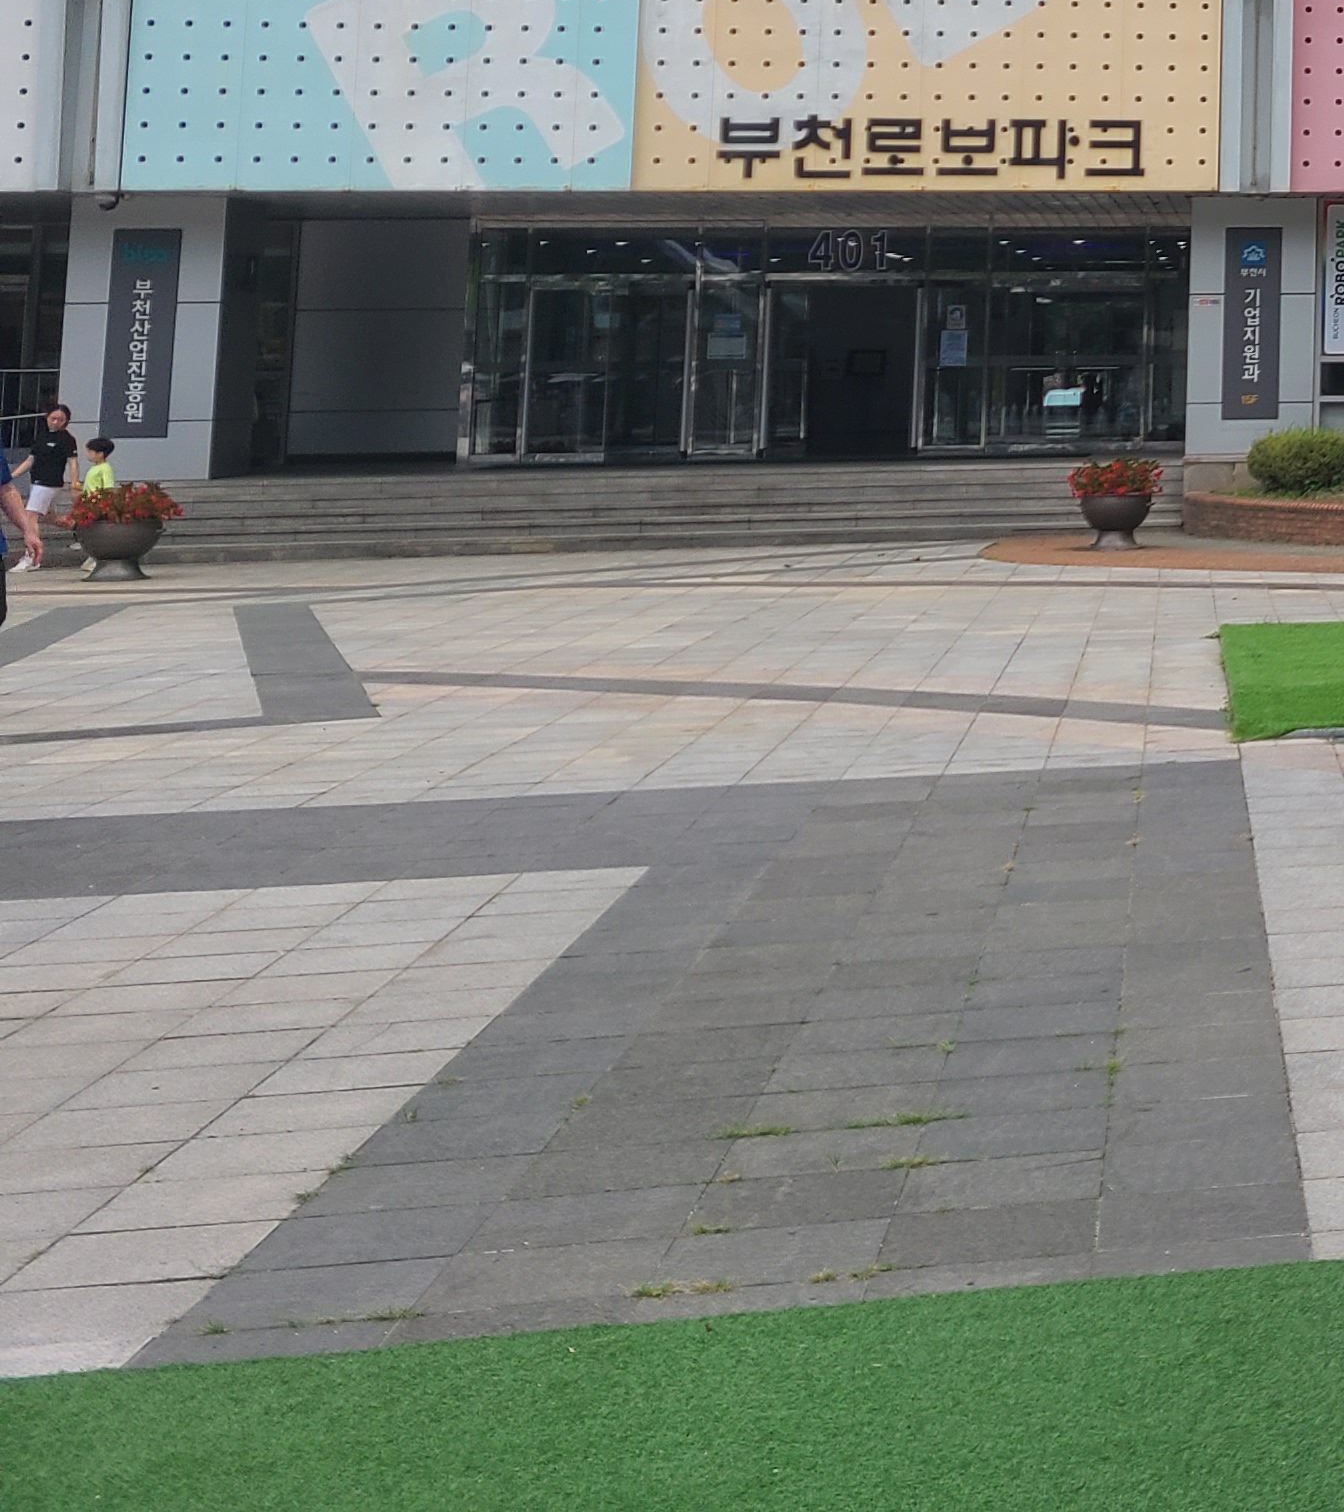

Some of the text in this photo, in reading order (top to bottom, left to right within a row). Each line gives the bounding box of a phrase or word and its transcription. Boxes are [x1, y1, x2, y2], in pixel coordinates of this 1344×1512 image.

[716, 114, 1146, 179] 부천로보파크
[808, 229, 889, 272] 401
[123, 279, 154, 424] 부천산업진흥원
[1241, 288, 1261, 383] 기업지원과
